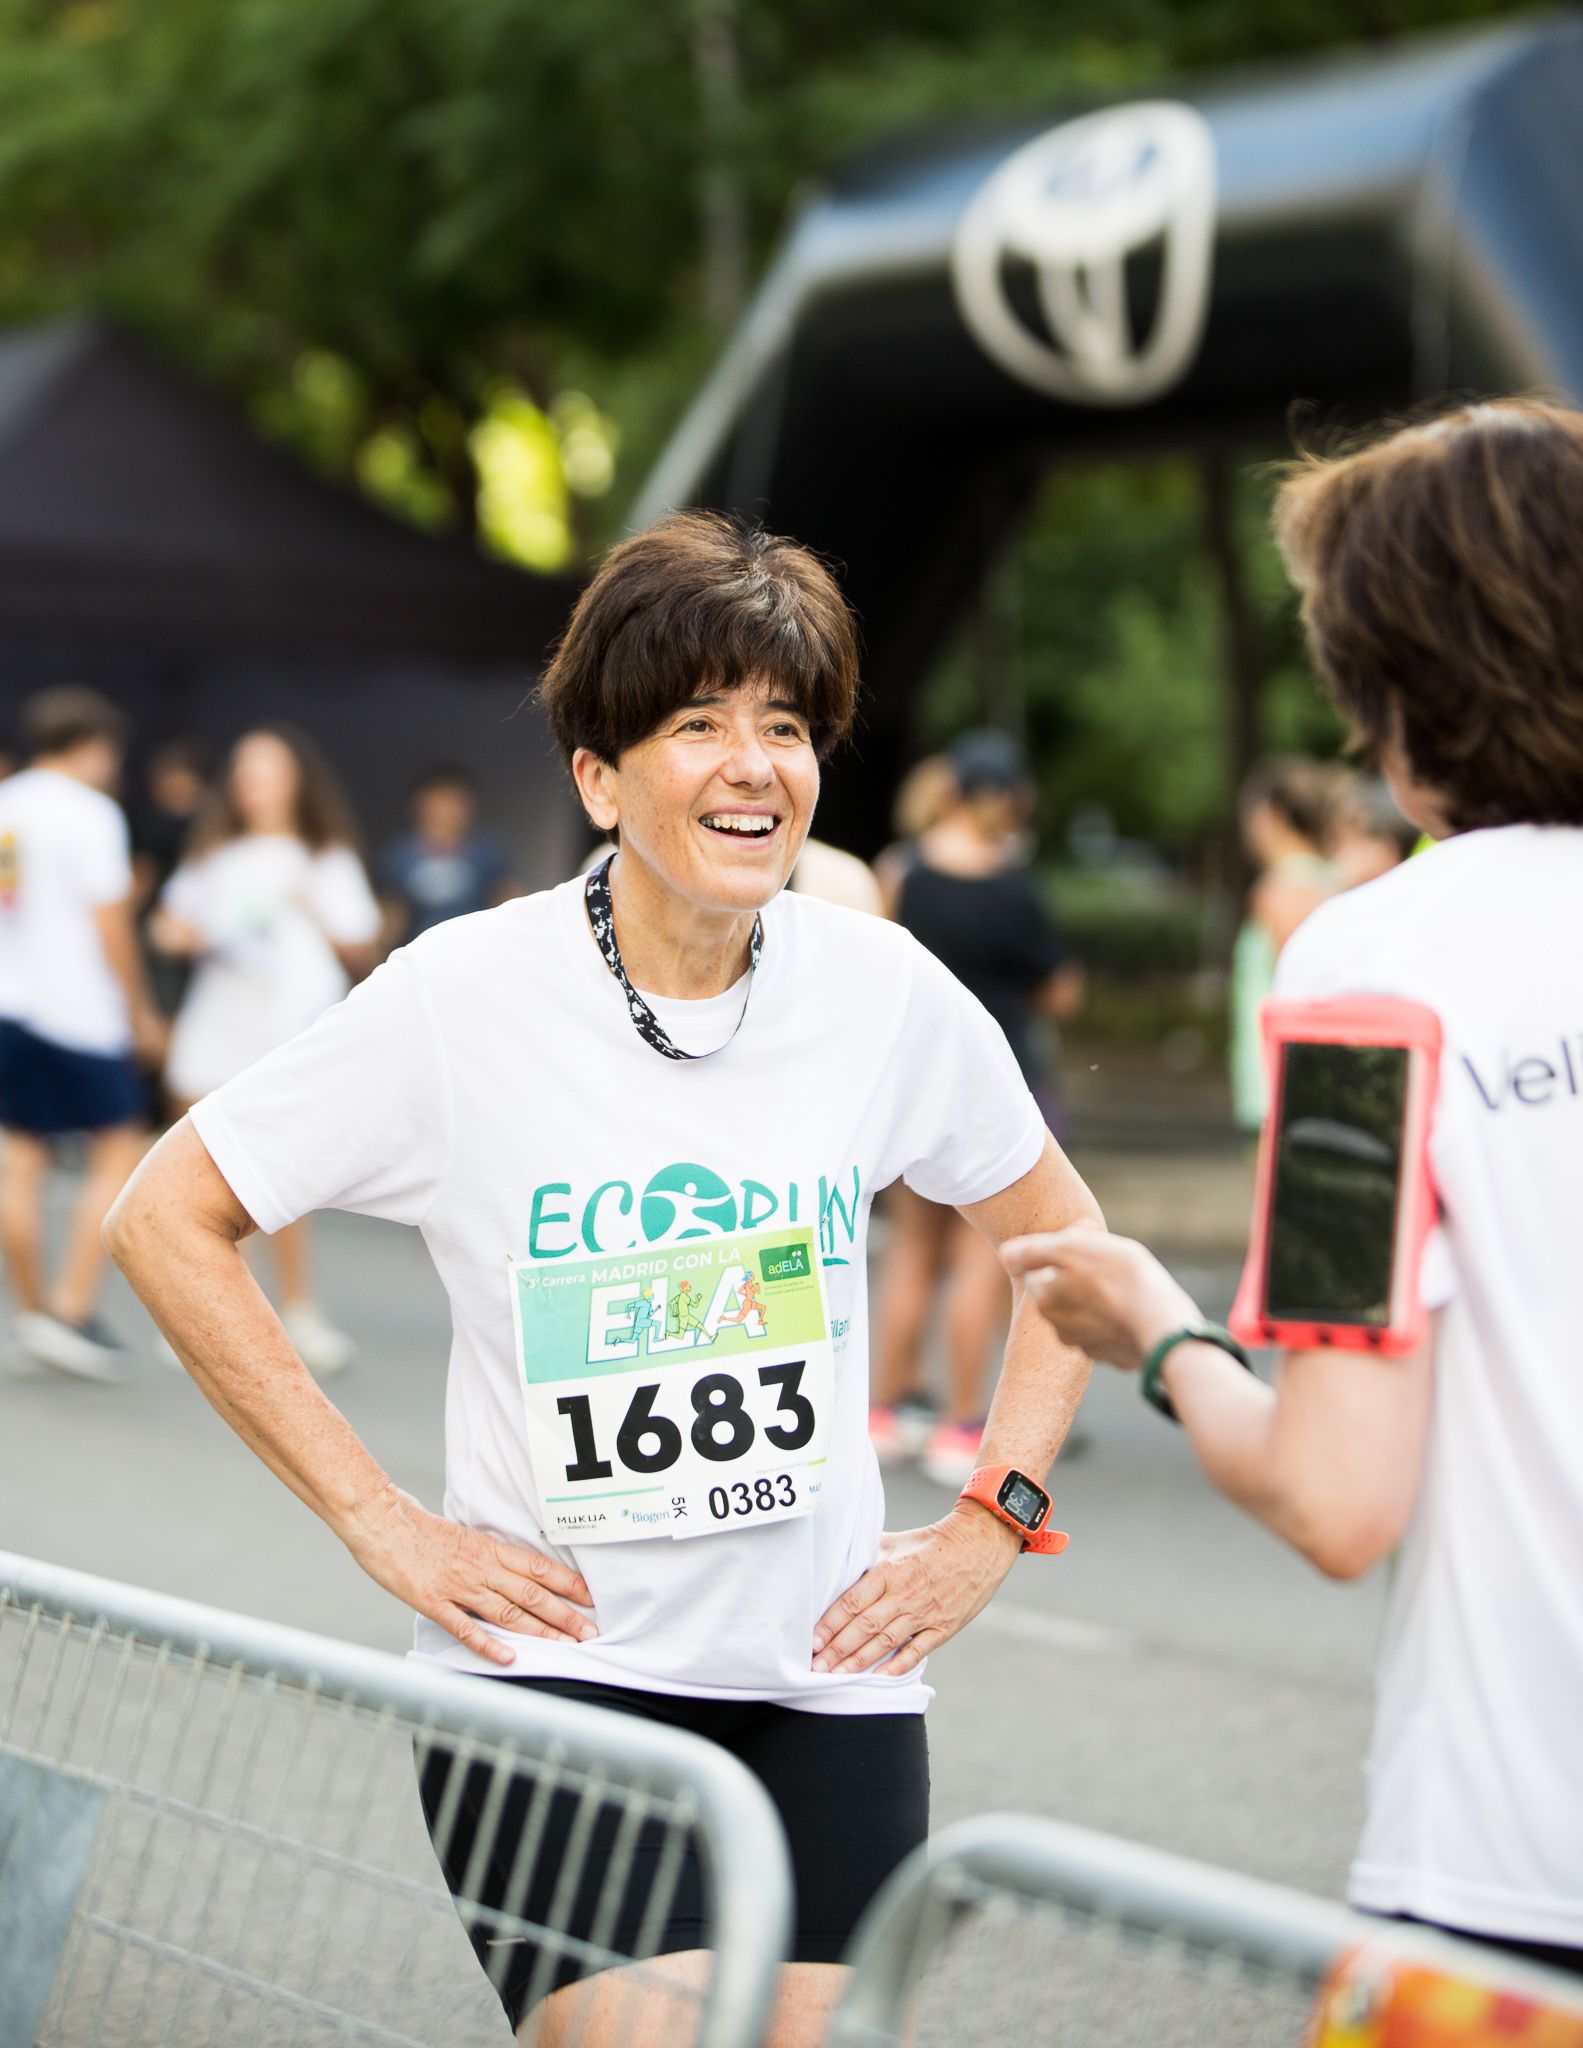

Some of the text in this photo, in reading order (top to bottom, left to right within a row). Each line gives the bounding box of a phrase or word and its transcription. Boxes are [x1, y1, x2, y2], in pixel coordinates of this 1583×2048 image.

[1461, 1036, 1583, 1112] Vel
[542, 1273, 586, 1288] Carrera
[592, 1259, 668, 1285] MADRID
[673, 1250, 713, 1270] CON
[718, 1247, 742, 1264] LA
[767, 1258, 804, 1275] adELA
[586, 1264, 768, 1364] ELA
[557, 1360, 816, 1482] 1683
[632, 1510, 670, 1523] Biogen
[671, 1496, 688, 1519] 5K
[708, 1474, 797, 1519] 0383
